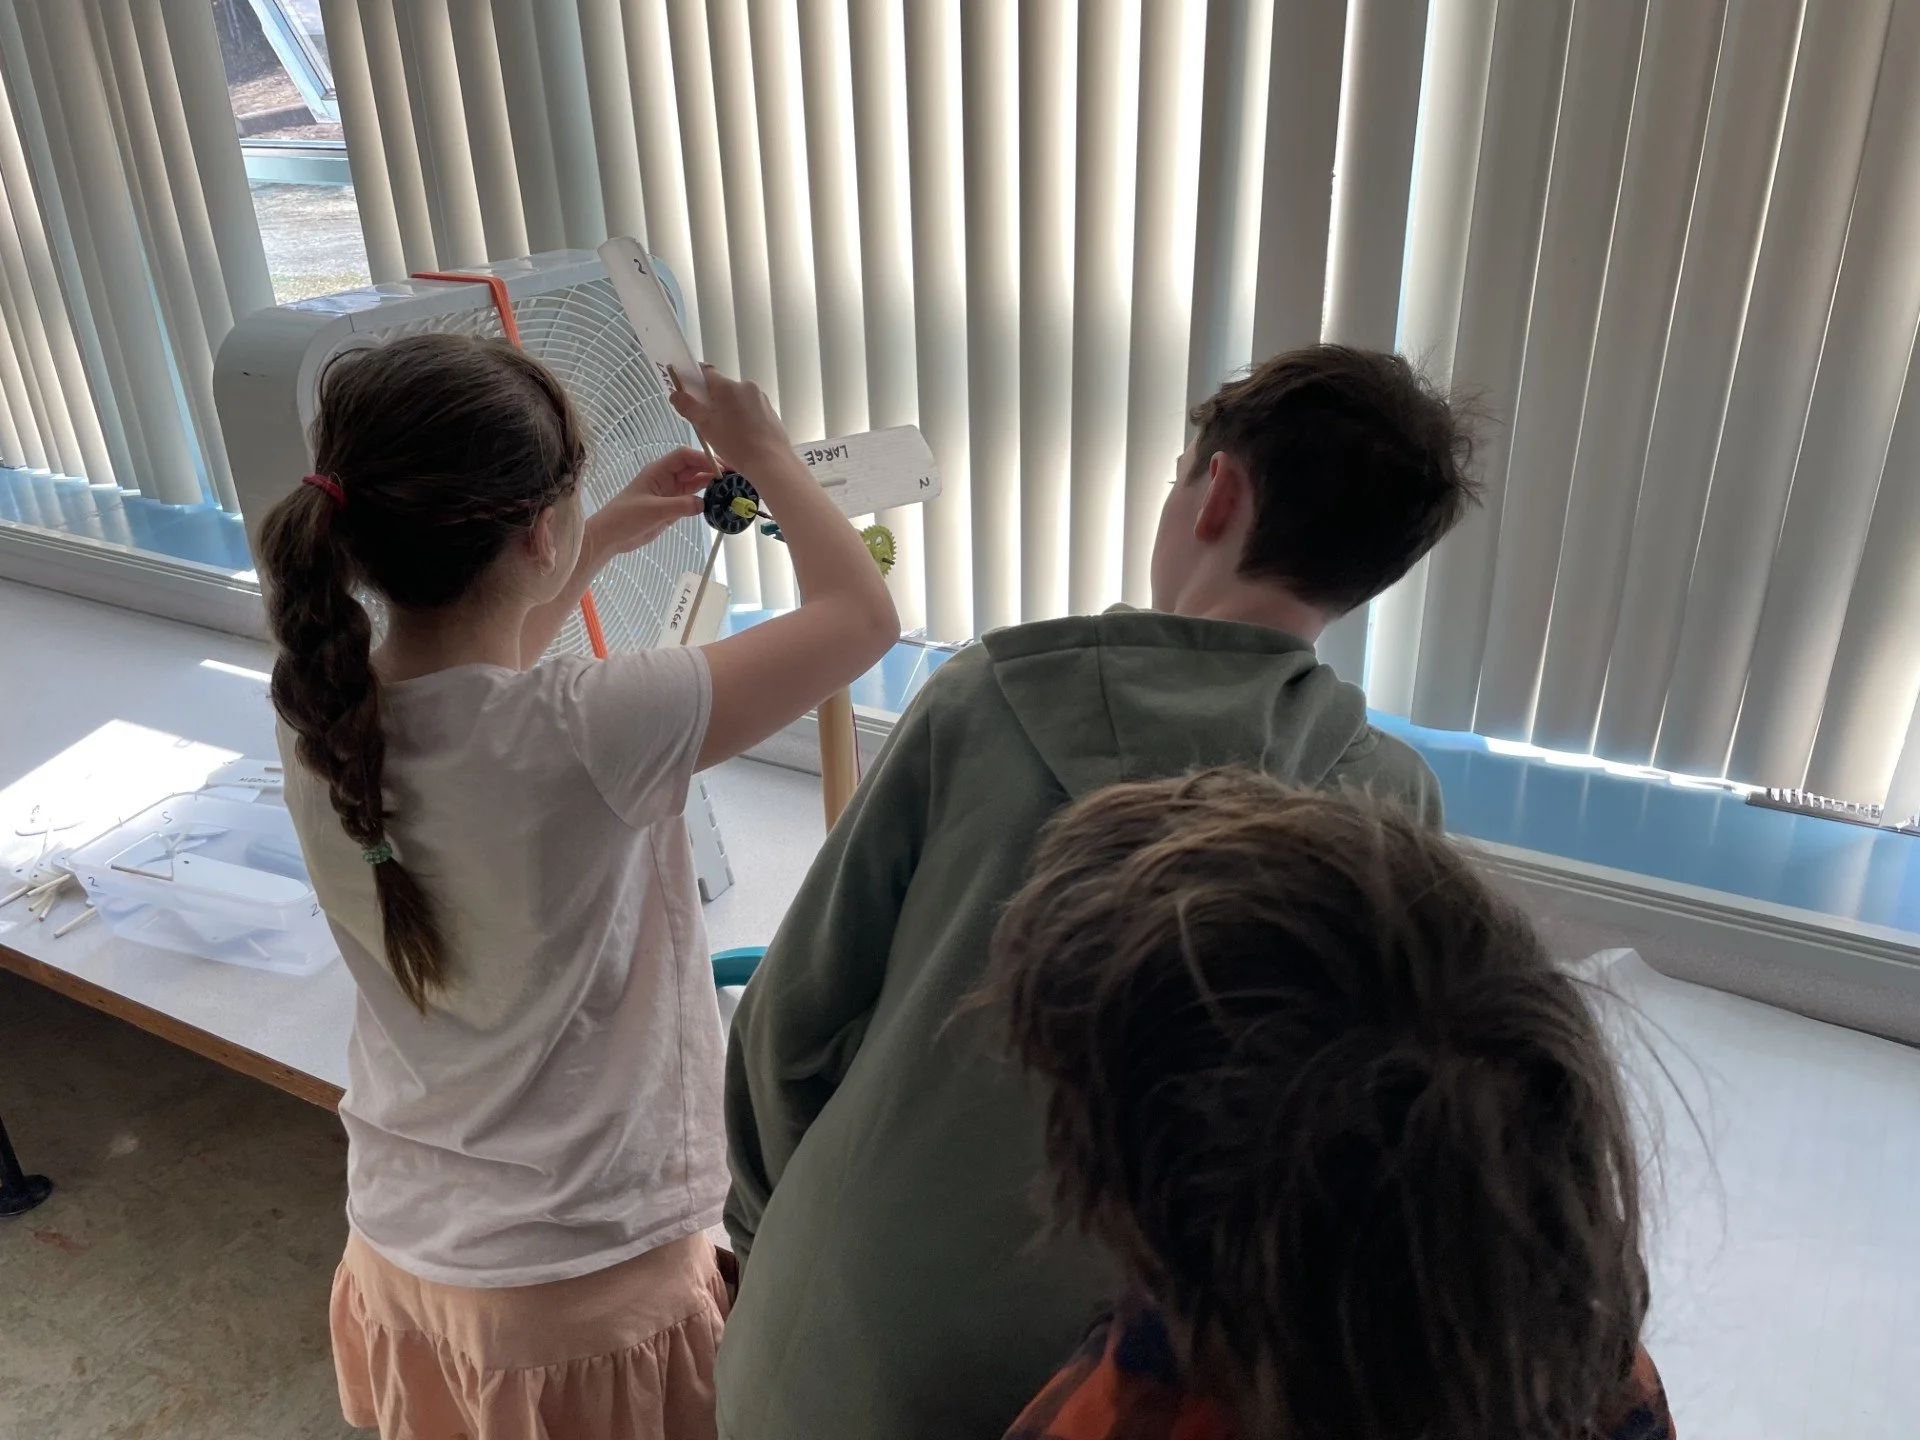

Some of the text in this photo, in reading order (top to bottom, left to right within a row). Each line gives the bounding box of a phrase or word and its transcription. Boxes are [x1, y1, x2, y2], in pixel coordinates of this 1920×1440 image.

[633, 258, 648, 275] 2
[804, 444, 849, 467] LARGE
[919, 476, 930, 489] 2
[670, 588, 691, 630] LARGE
[87, 876, 100, 888] 2
[310, 903, 321, 917] 2
